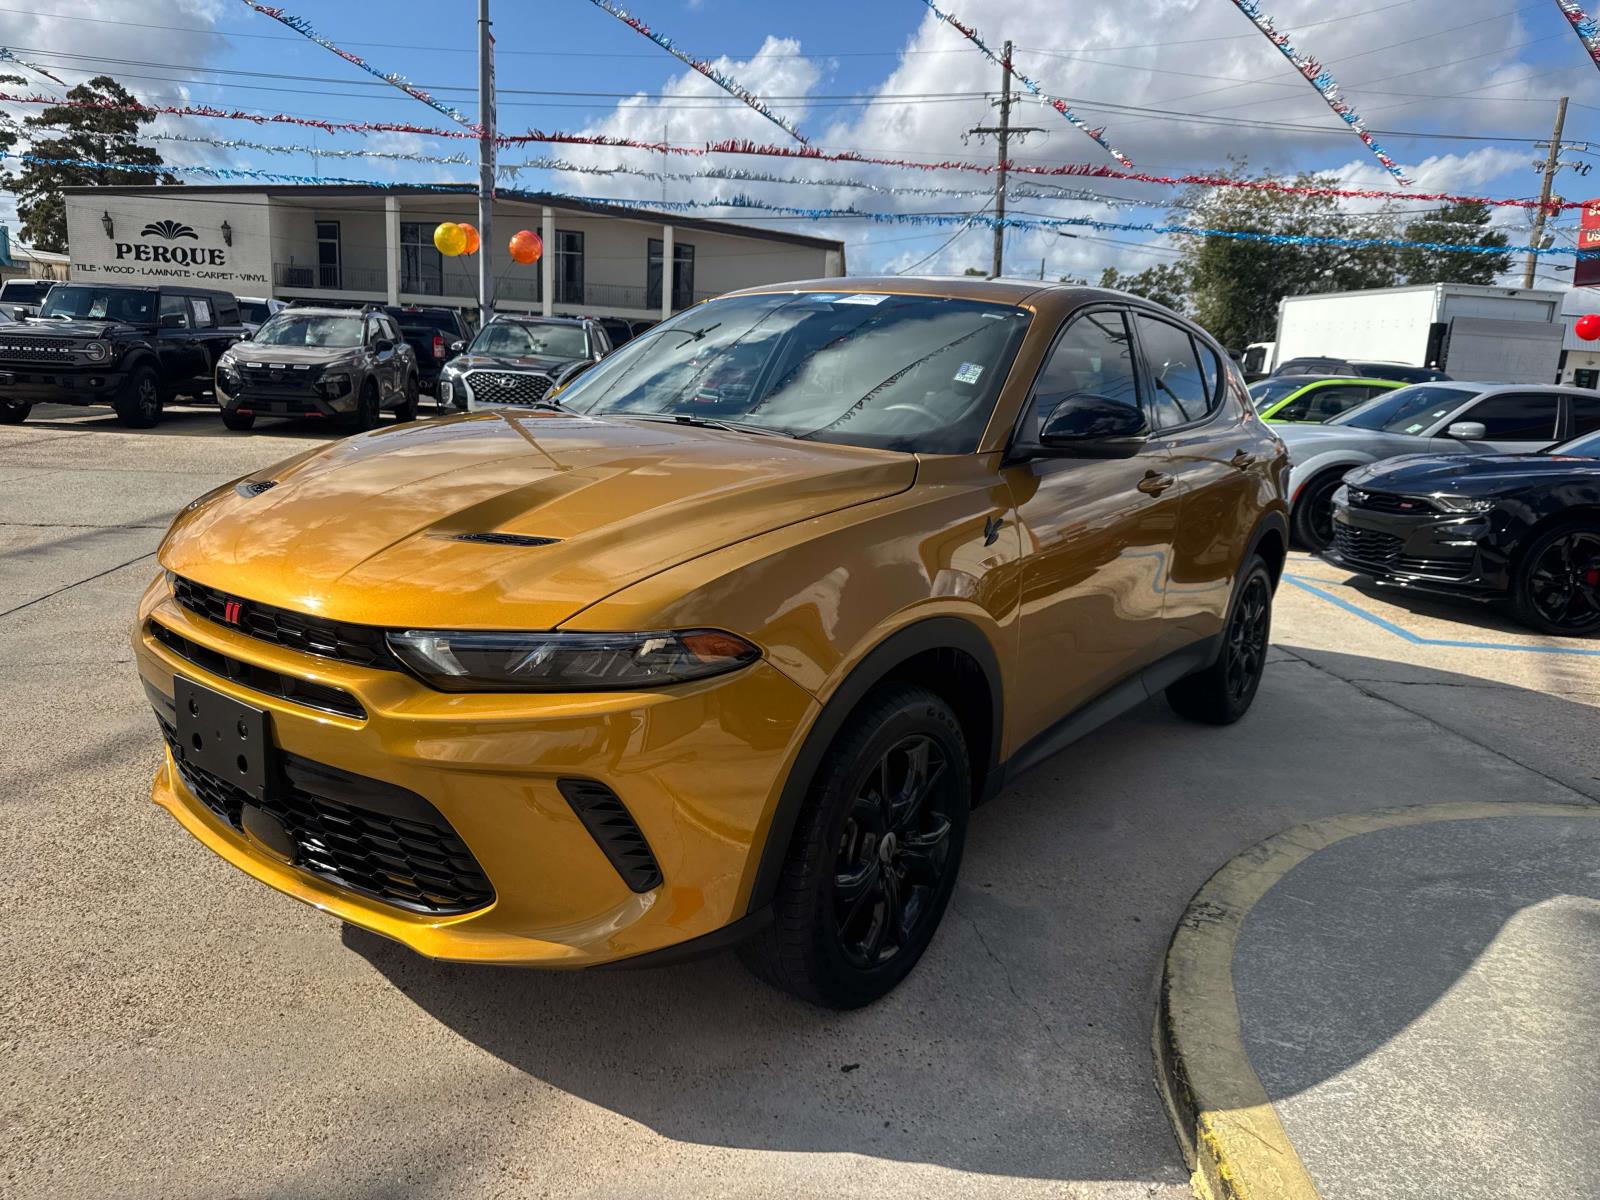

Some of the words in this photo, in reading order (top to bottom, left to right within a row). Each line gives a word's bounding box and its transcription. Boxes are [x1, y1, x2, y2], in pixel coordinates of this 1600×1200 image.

[115, 242, 226, 267] PERQUE
[75, 263, 96, 272] TILE
[104, 265, 135, 275] WOOD
[141, 266, 191, 278] LAMINATE
[196, 270, 234, 280] CARPET
[239, 273, 268, 283] VINYL
